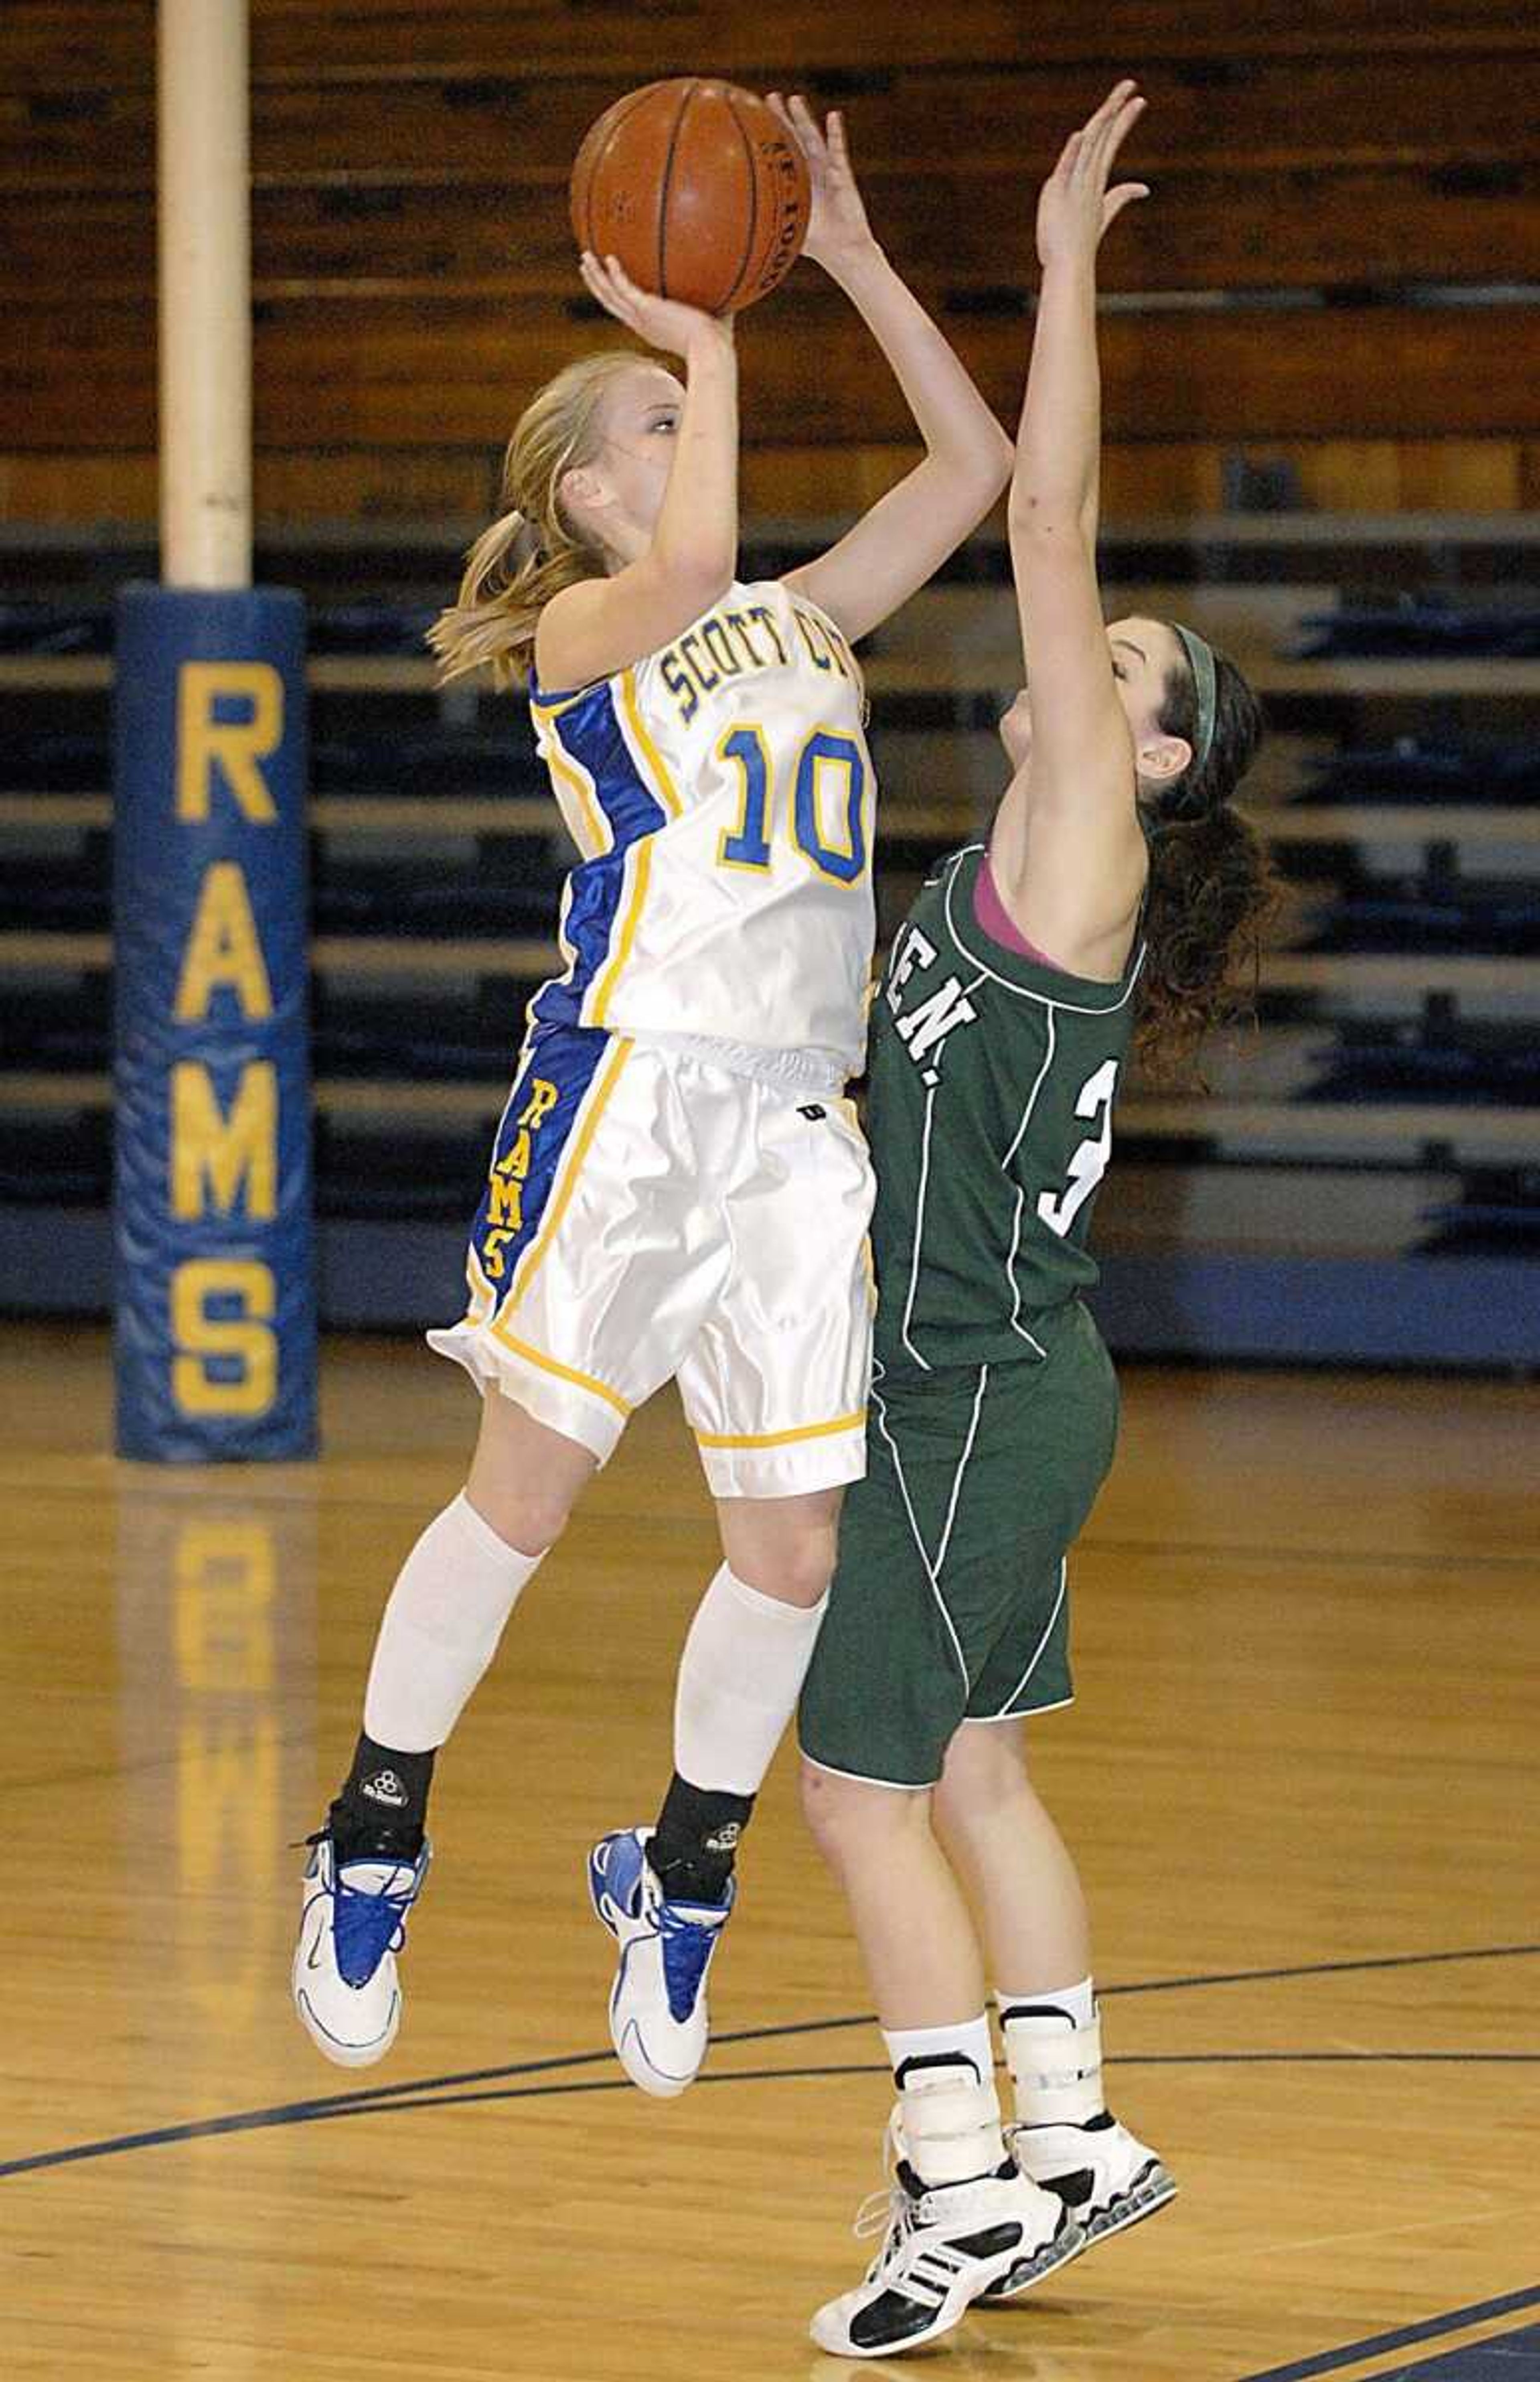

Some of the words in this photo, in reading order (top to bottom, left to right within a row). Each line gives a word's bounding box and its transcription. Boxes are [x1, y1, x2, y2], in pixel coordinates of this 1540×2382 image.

[658, 605, 788, 724] SCOTT
[716, 721, 867, 890] 10
[170, 661, 283, 1416] RAMS
[484, 1078, 558, 1278] RAMS
